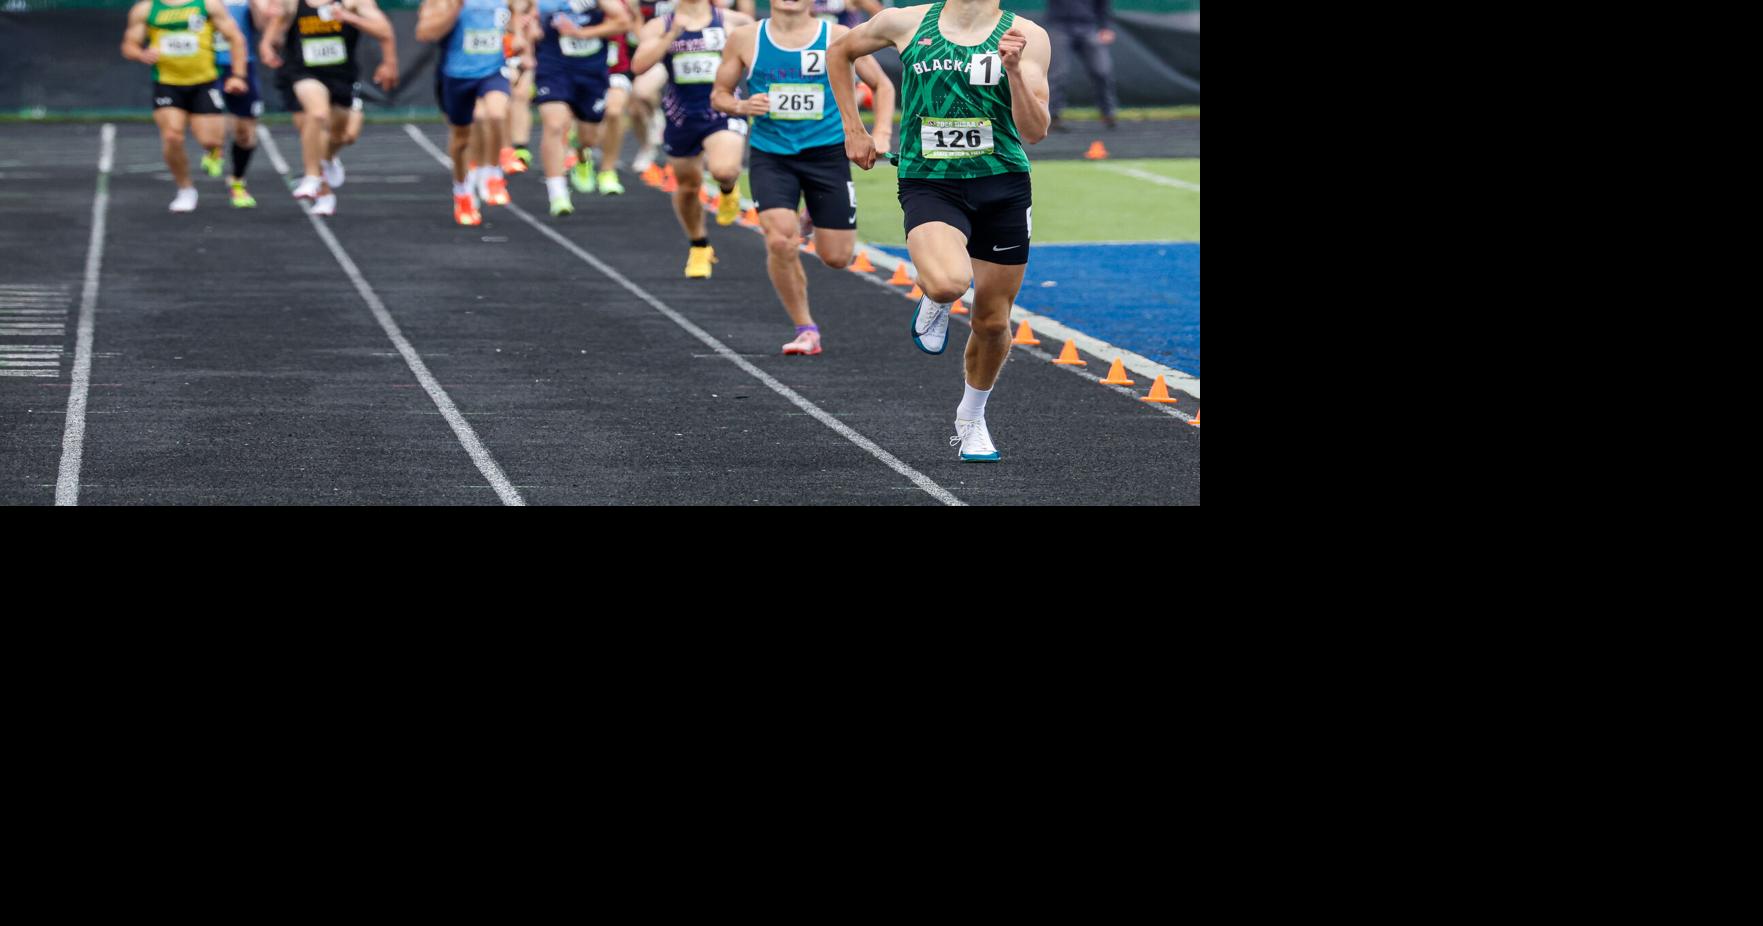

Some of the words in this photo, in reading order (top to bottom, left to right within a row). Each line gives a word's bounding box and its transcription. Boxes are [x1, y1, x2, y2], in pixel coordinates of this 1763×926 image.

[806, 52, 821, 73] 2
[979, 55, 993, 84] 1
[778, 94, 815, 111] 265
[933, 129, 982, 148] 126
